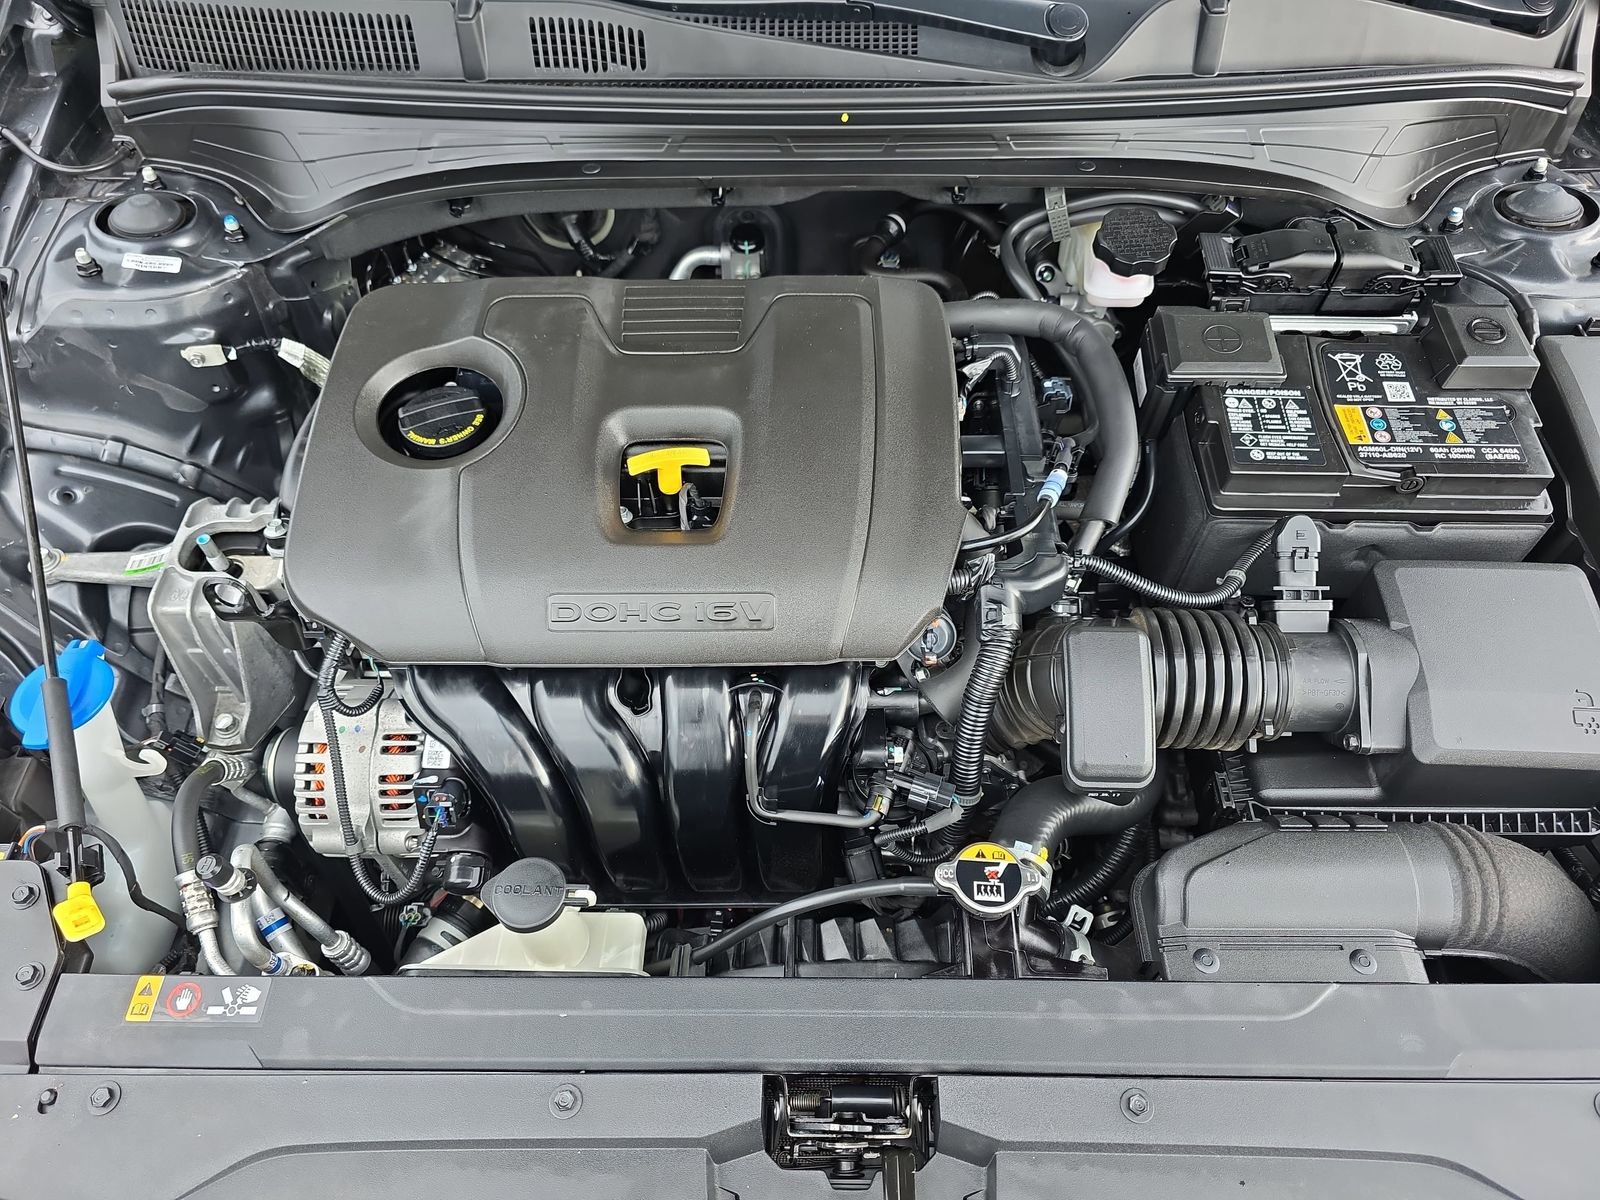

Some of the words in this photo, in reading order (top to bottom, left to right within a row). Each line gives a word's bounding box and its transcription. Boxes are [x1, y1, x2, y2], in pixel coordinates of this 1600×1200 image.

[1347, 382, 1366, 392] Pb
[472, 414, 484, 426] SEE
[406, 430, 437, 445] MANUAL
[438, 425, 475, 445] OWNER'S
[550, 601, 682, 622] DOHC
[694, 601, 772, 622] 16V
[937, 868, 954, 879] HCC
[494, 884, 564, 897] COOLANT
